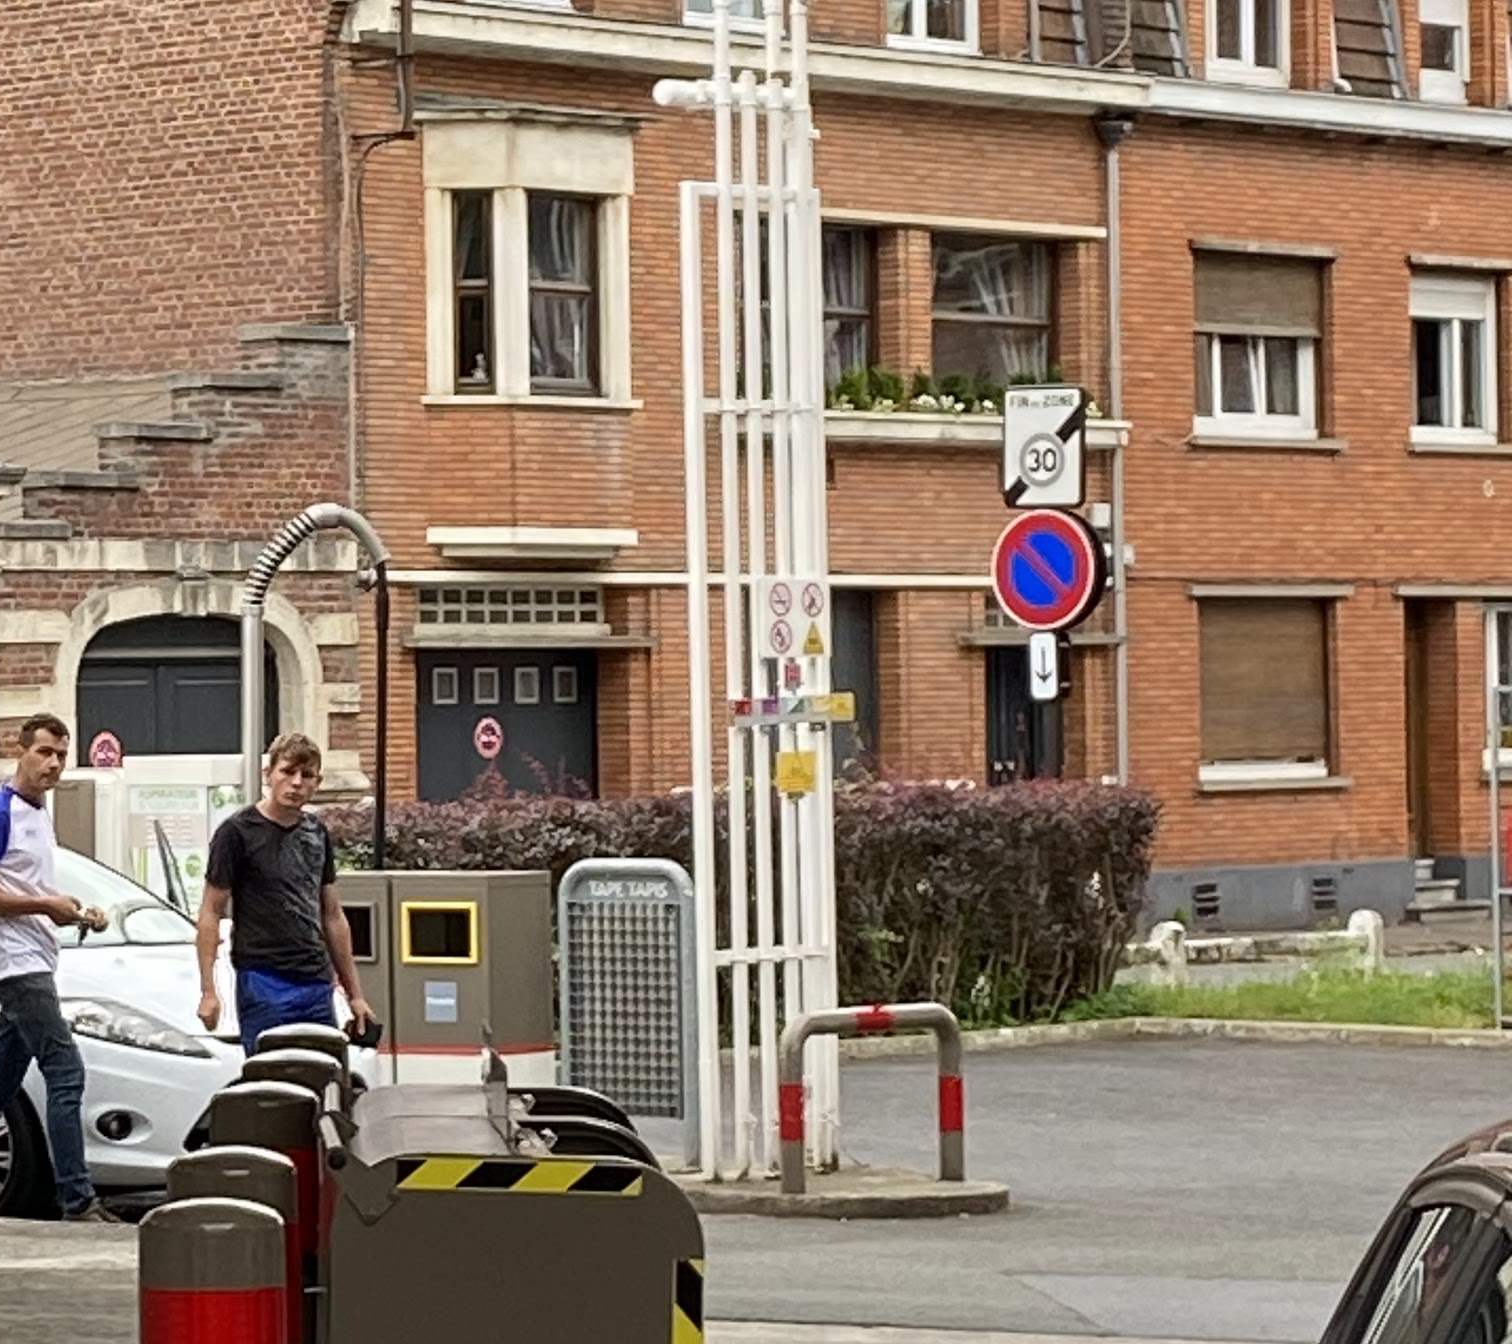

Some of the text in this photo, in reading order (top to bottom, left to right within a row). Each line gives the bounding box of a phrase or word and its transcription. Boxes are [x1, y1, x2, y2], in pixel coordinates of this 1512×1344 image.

[1027, 448, 1057, 472] 30
[588, 880, 669, 899] TAPE TAPIS
